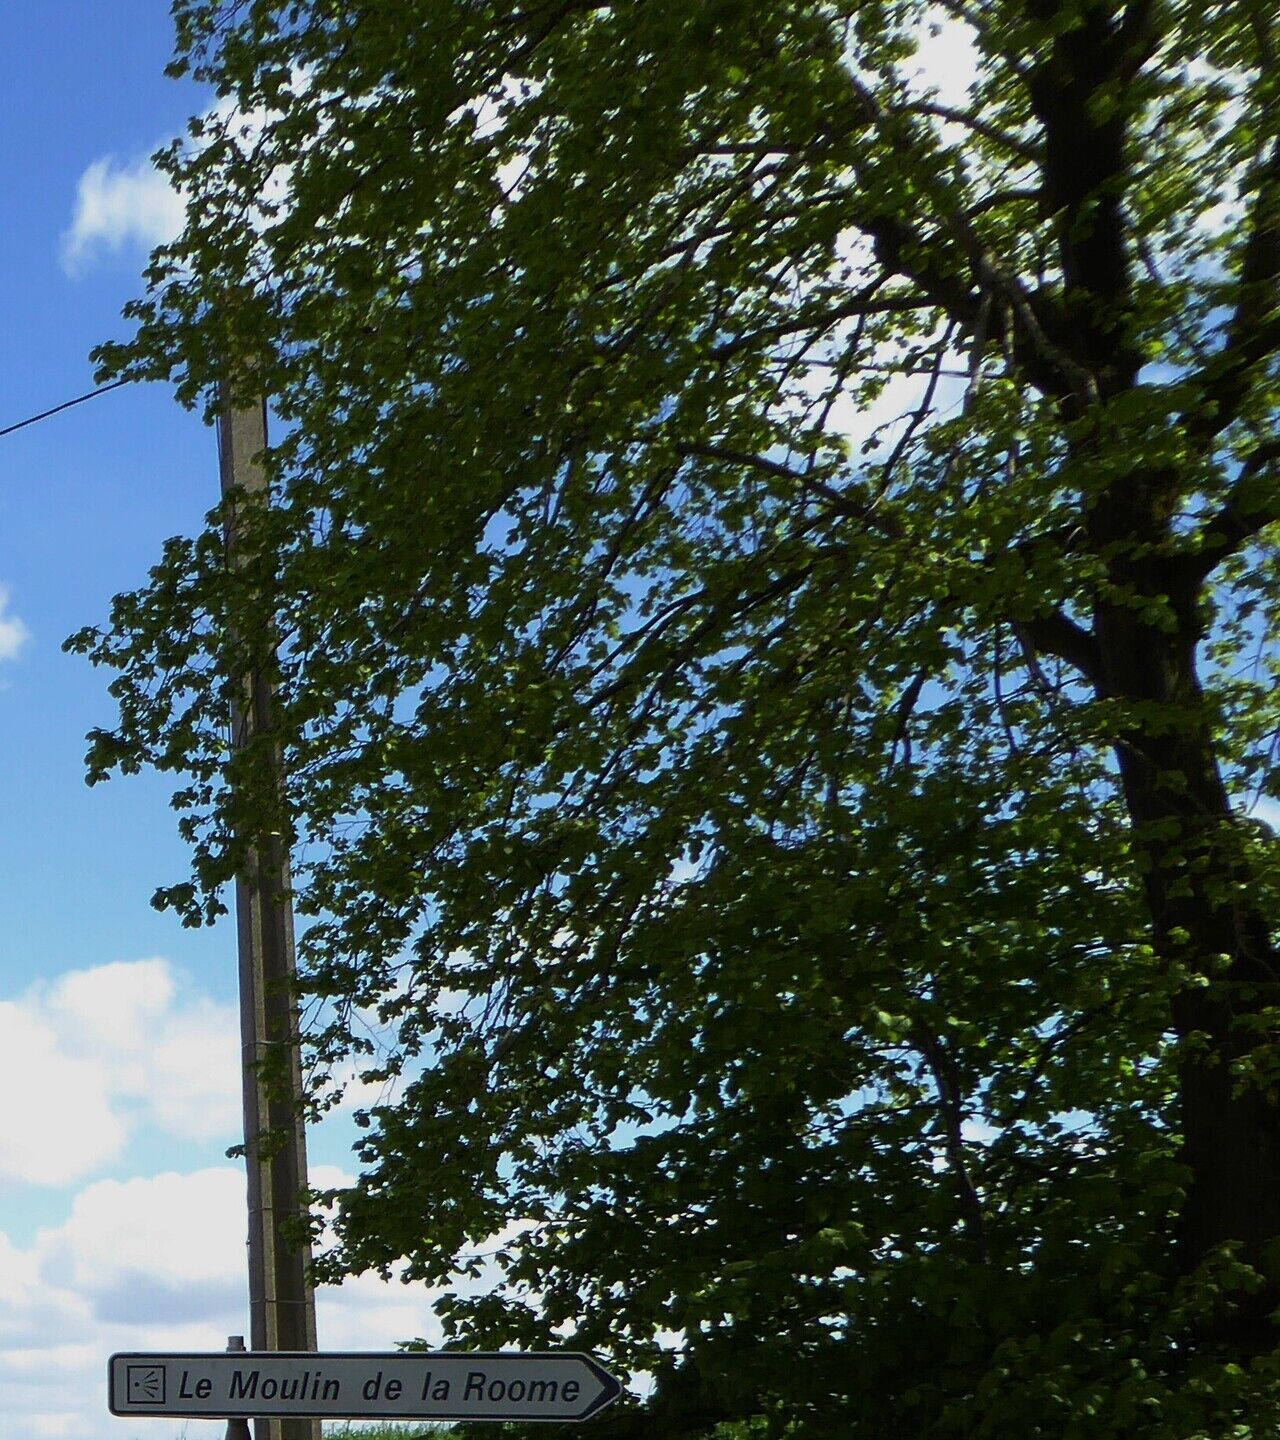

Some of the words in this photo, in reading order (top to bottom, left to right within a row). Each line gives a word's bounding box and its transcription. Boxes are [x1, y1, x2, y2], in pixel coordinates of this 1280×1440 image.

[178, 1370, 212, 1400] Le
[229, 1370, 340, 1401] Moulin
[362, 1371, 403, 1401] de
[420, 1371, 450, 1401] la
[463, 1371, 580, 1402] Roome
